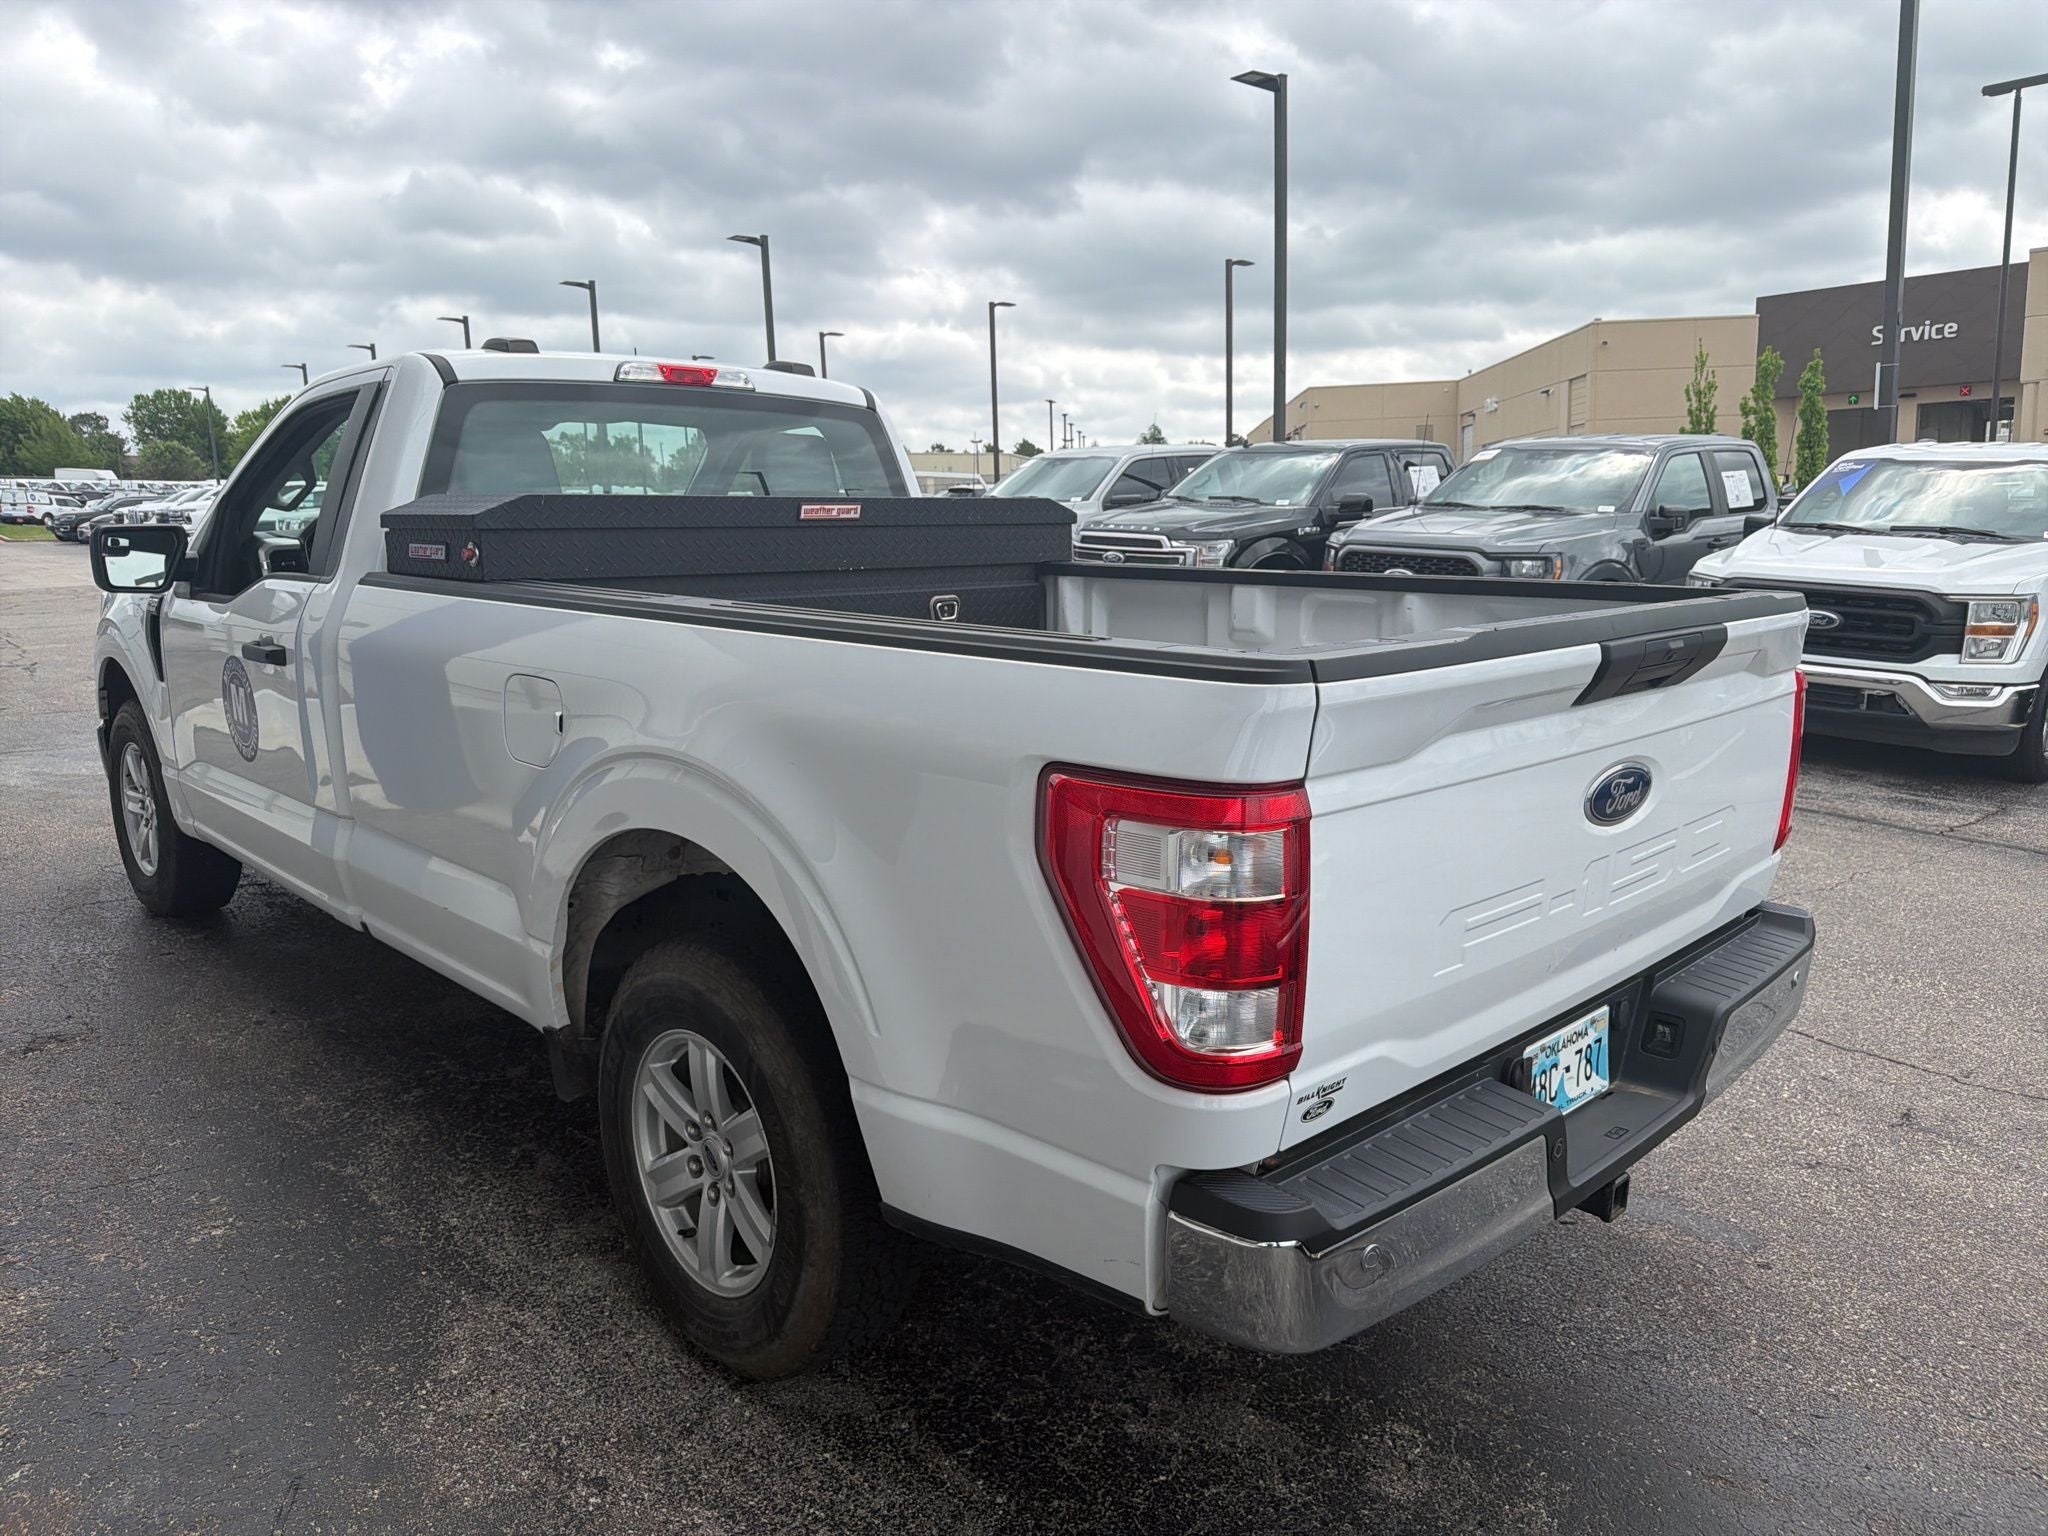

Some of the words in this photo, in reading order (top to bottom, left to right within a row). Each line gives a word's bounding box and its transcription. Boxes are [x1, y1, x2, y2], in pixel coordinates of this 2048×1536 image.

[1871, 320, 1959, 346] Srvice
[803, 507, 835, 515] weather
[836, 506, 859, 517] guard
[1605, 776, 1643, 814] Ford
[1434, 804, 1736, 977] F-150
[1545, 1026, 1589, 1059] OKLAHOMA
